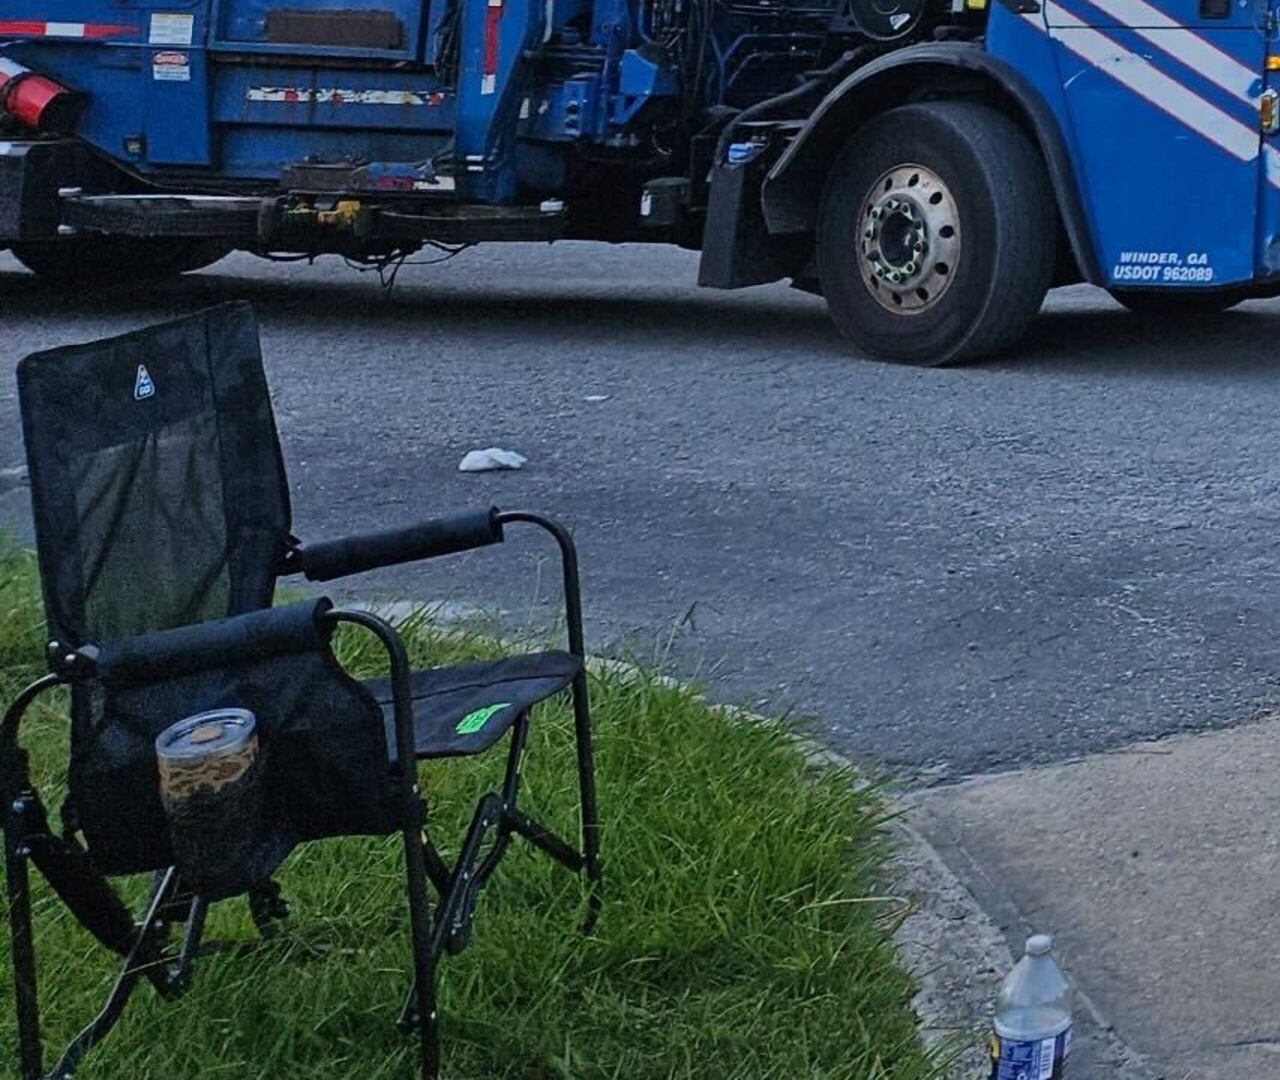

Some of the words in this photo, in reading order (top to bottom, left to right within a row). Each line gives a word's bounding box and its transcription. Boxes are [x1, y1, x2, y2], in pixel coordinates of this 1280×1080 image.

[1121, 251, 1183, 265] WINDER,
[1187, 253, 1208, 265] GA
[1113, 265, 1162, 280] USDOT
[1163, 266, 1213, 281] 962089
